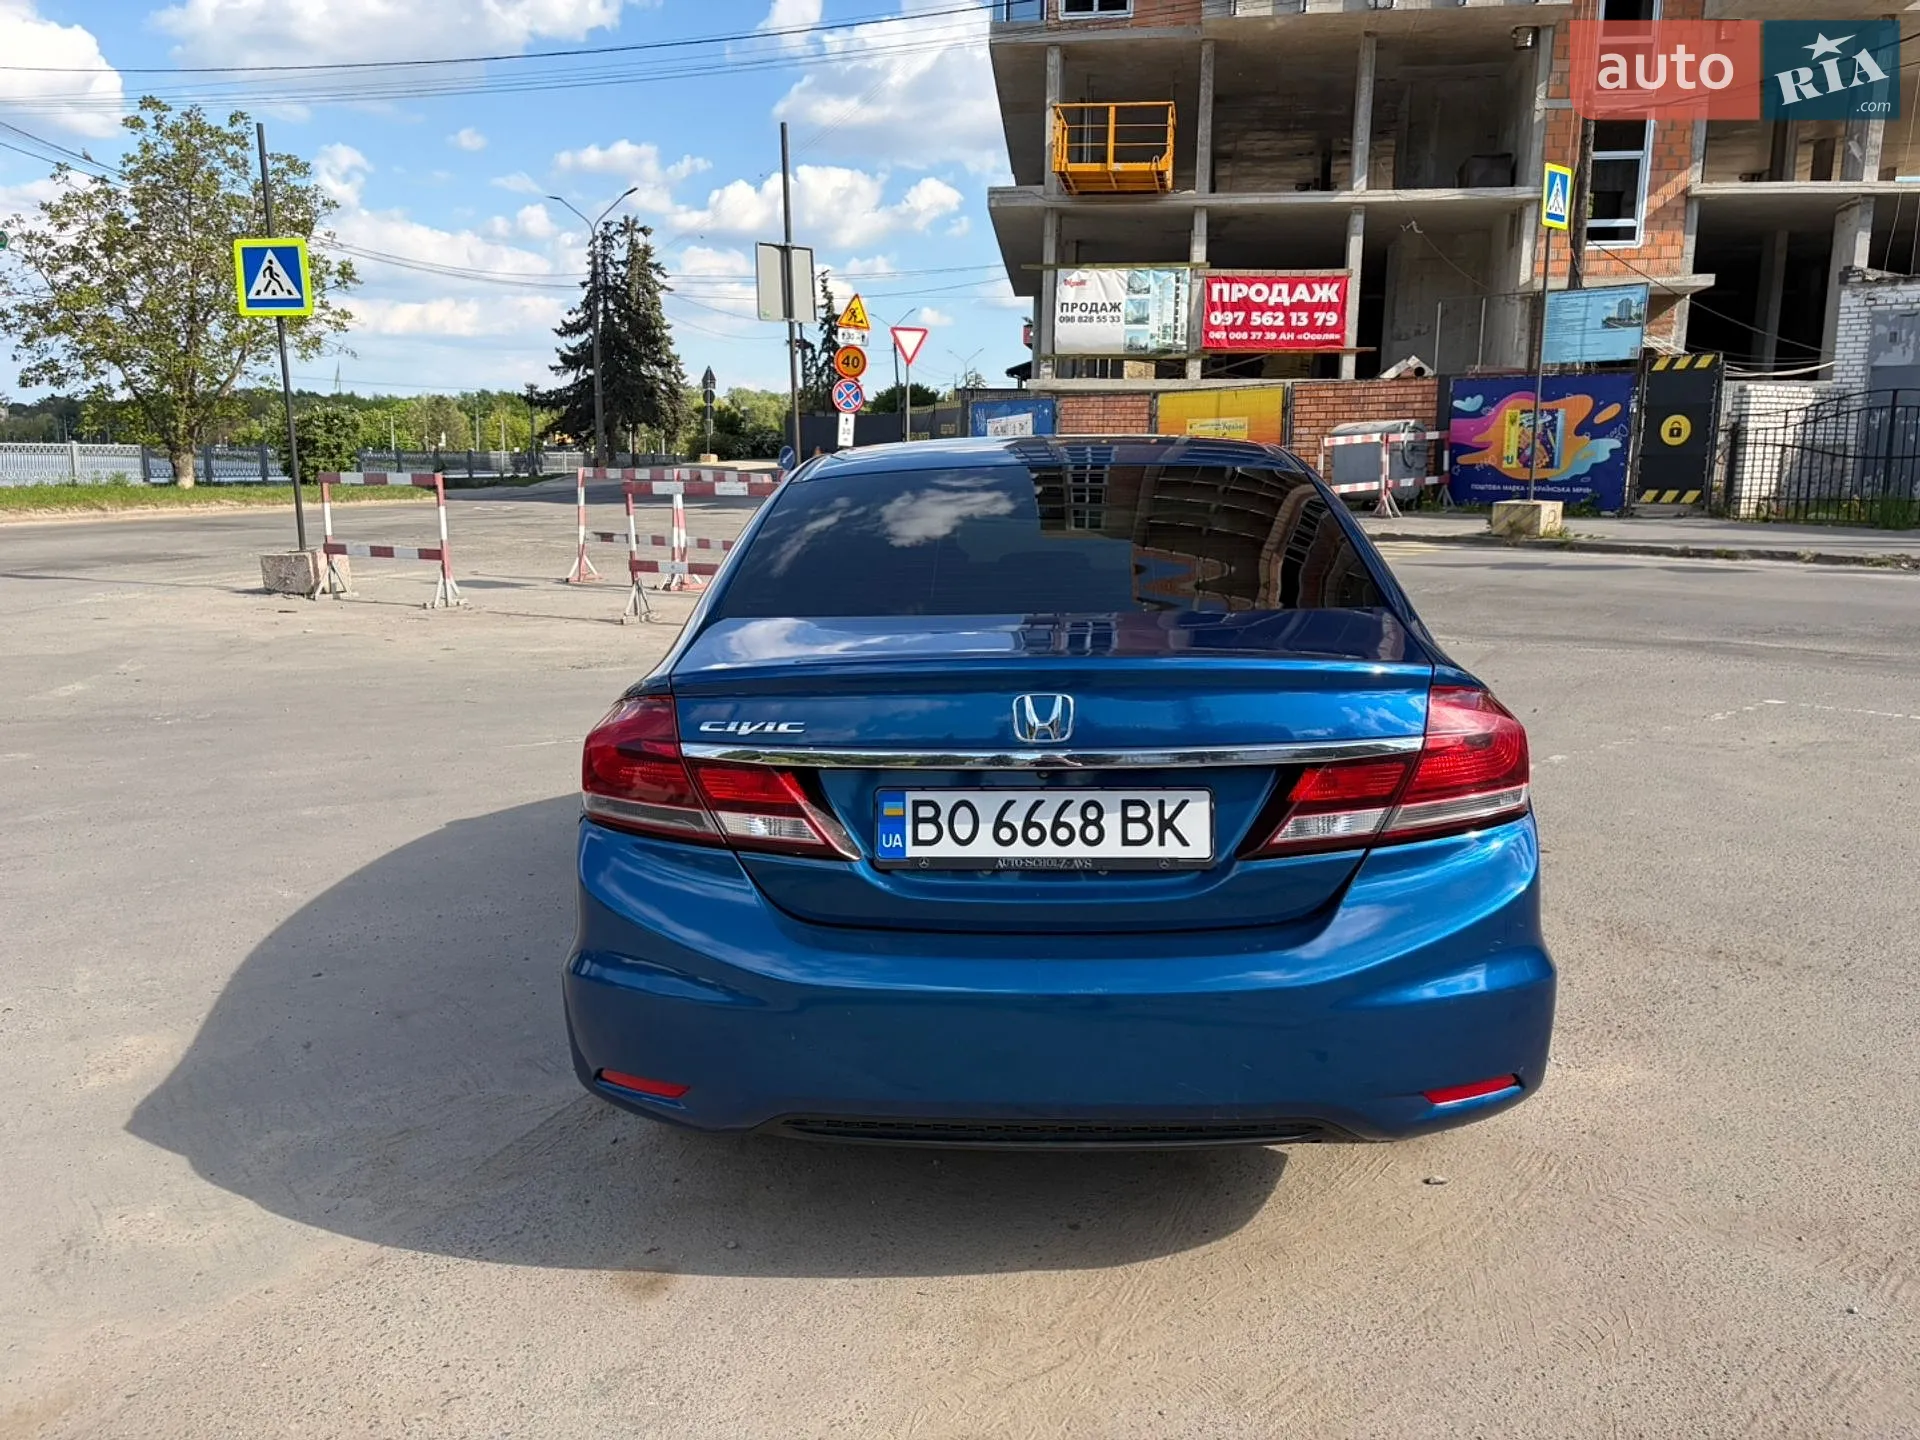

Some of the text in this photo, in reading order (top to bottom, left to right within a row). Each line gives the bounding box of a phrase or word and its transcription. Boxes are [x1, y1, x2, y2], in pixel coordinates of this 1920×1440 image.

[1211, 282, 1340, 307] ПРОДАЖ
[1060, 301, 1122, 315] ПРОДАЖ
[1096, 315, 1107, 323] 55
[1109, 315, 1121, 323] 33
[1209, 311, 1338, 327] 097 562 13 79
[1278, 332, 1295, 341] АН
[841, 355, 860, 368] 40
[910, 799, 1191, 847] BO 6668 BK
[882, 833, 904, 848] UA
